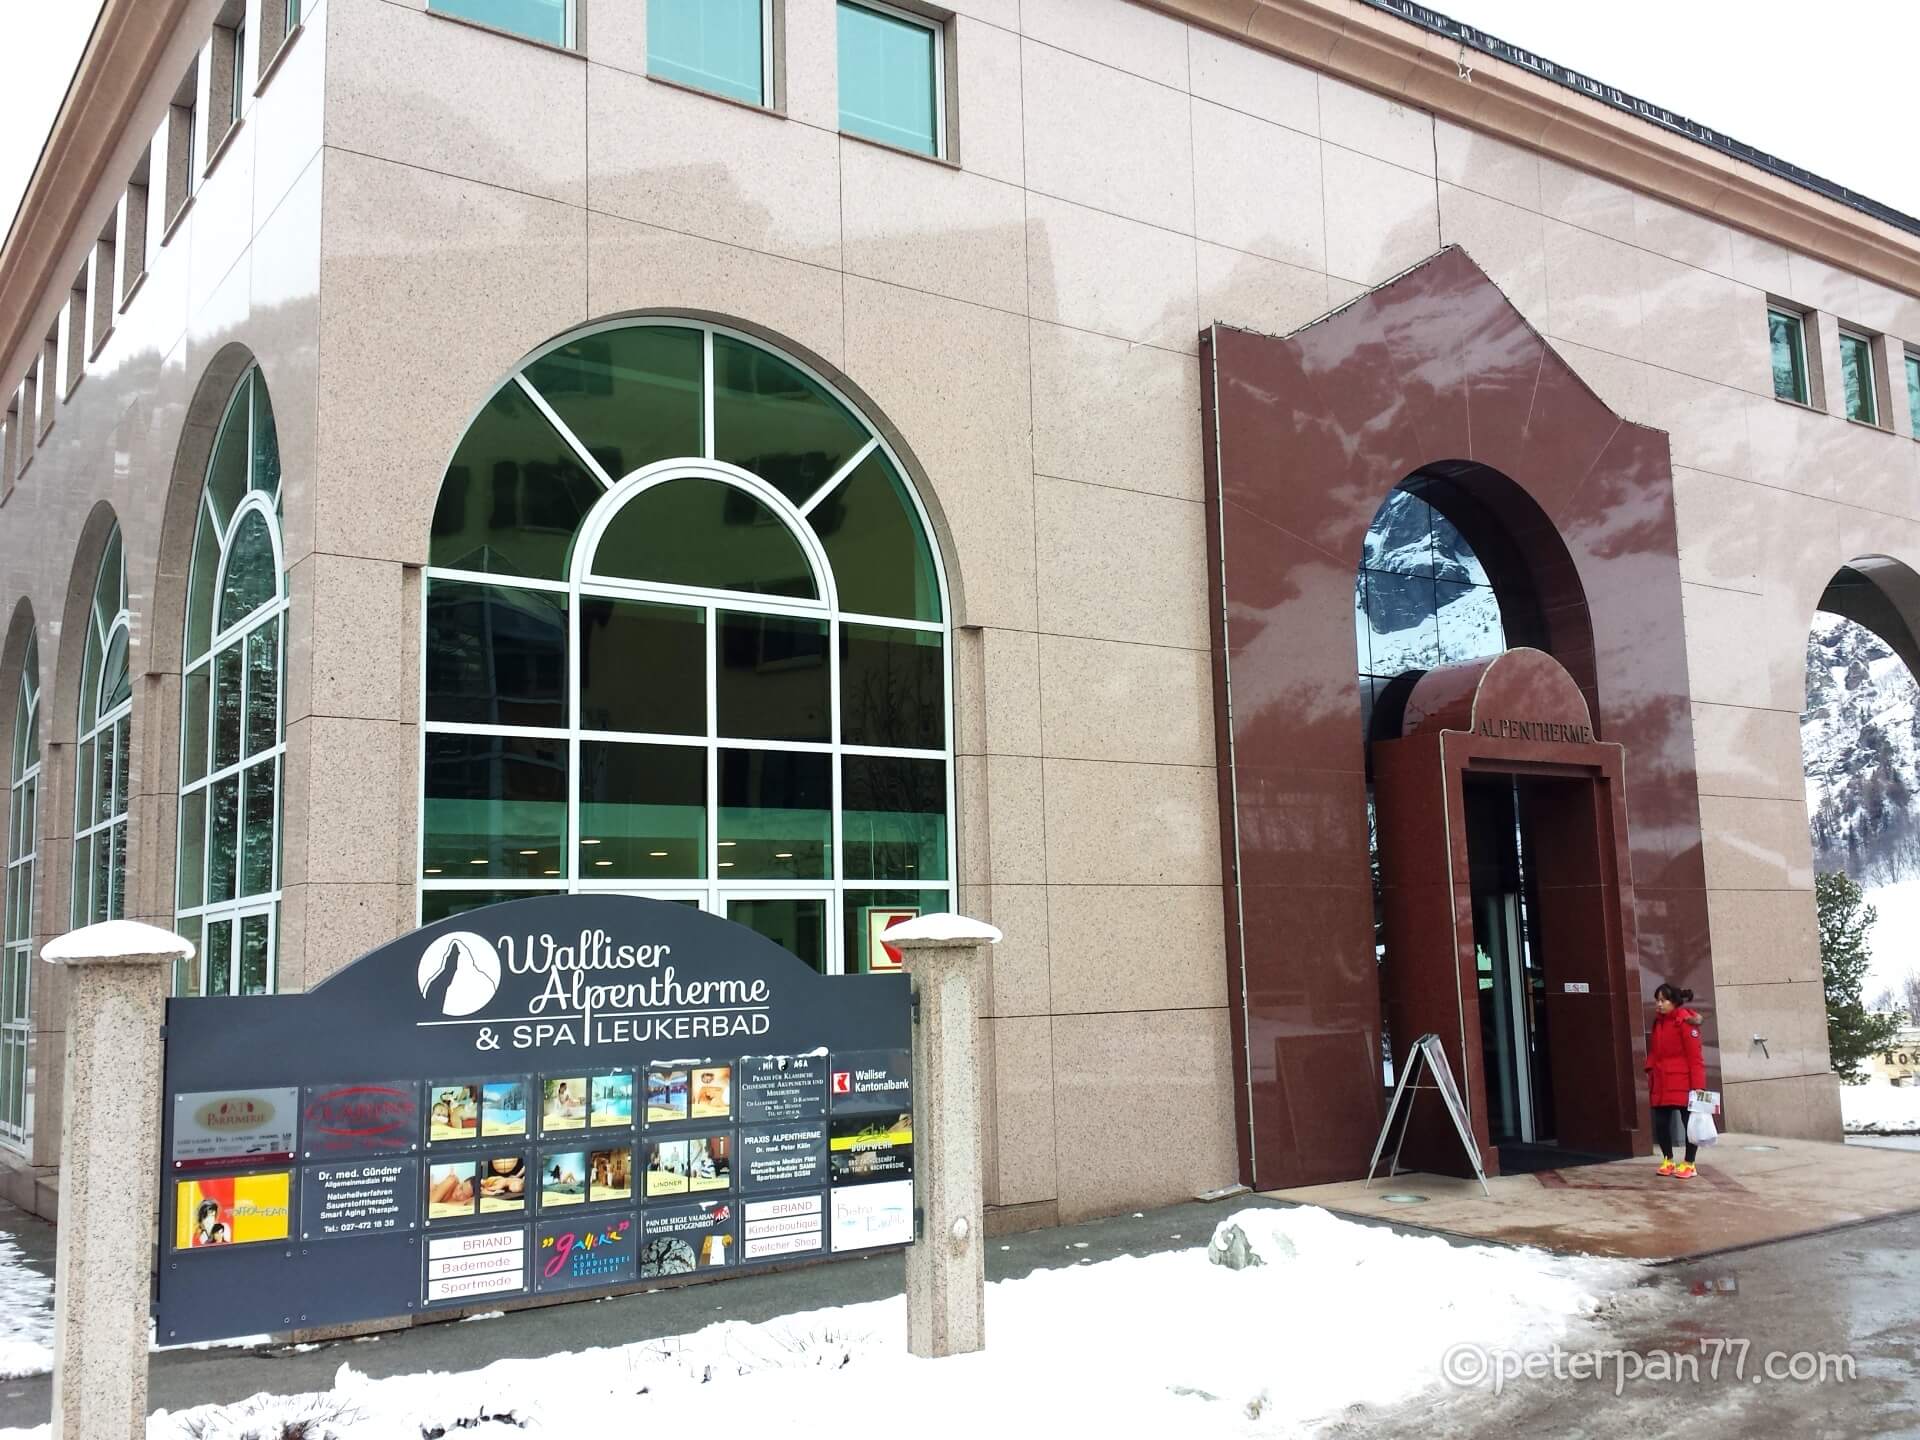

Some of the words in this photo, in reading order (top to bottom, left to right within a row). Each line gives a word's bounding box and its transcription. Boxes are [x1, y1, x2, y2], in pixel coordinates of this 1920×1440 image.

[1479, 718, 1590, 744] ALPENTHERME
[498, 929, 671, 974] Walliser
[529, 965, 770, 1046] Alpentherme
[475, 1027, 501, 1051] &
[512, 1024, 577, 1048] SPA
[597, 1013, 771, 1044] LEUKERBAD
[855, 1069, 887, 1081] Walliser
[855, 1078, 910, 1093] Kantonalbank
[744, 1135, 770, 1145] PRAXIS
[772, 1131, 822, 1142] ALPENTHERME
[318, 1171, 332, 1181] Dr.
[336, 1168, 360, 1179] med.
[362, 1166, 402, 1177] Gündner
[325, 1177, 381, 1188] Allgemeinmedizin
[653, 1179, 682, 1189] LINDNER
[327, 1189, 393, 1201] Naturheilverfahren
[326, 1197, 394, 1210] Sauerstofftherapie
[772, 1201, 813, 1214] BRIAND
[320, 1210, 342, 1219] Smart
[345, 1209, 366, 1217] Aging
[368, 1206, 399, 1215] Therapie
[646, 1225, 674, 1234] WALLISER
[749, 1218, 818, 1234] Kinderboutique
[463, 1236, 513, 1251] BRIAND
[751, 1241, 790, 1253] Switcher
[794, 1238, 817, 1248] Shop
[442, 1257, 511, 1274] Bademode
[441, 1276, 512, 1294] Sportmode
